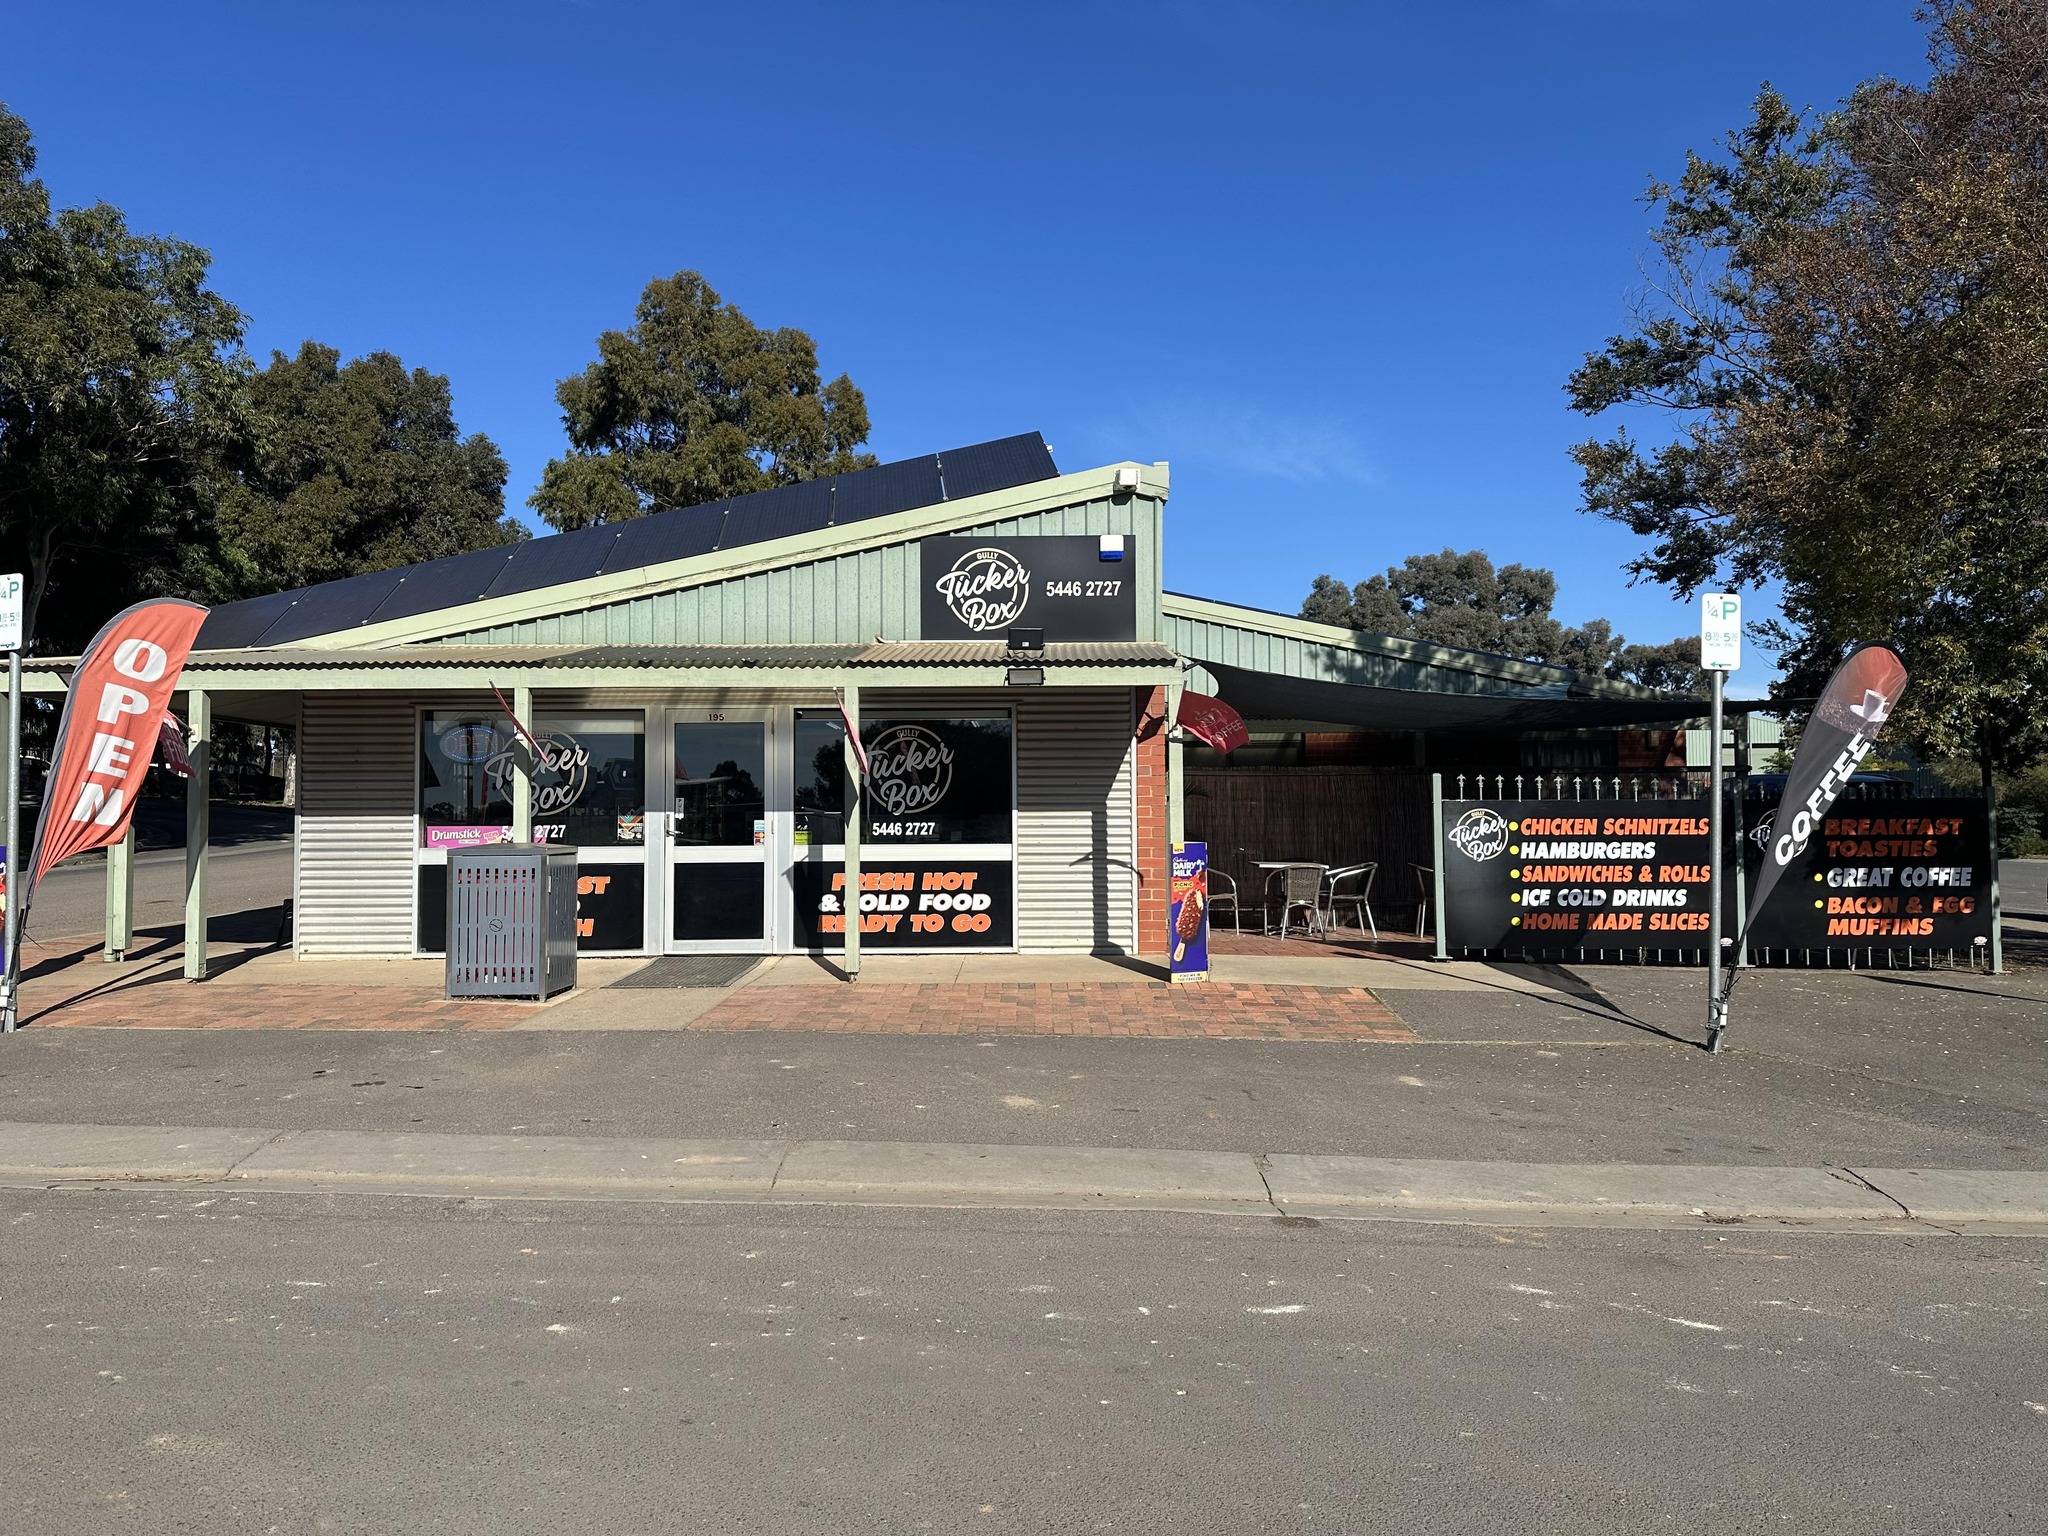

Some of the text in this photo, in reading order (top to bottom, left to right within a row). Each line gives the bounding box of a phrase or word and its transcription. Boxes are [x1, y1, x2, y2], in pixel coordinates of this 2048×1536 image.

[977, 552, 998, 560] GULLY
[936, 562, 1031, 606] Tucker
[1046, 581, 1121, 597] 5446 2727
[962, 597, 1017, 632] Box
[709, 713, 725, 721] 195
[71, 638, 167, 826] OPEN
[896, 729, 920, 737] GULLY
[1210, 720, 1244, 743] COFFEE
[444, 735, 498, 754] OPEN
[880, 779, 940, 815] Box
[1775, 732, 1871, 866] COFFEE
[432, 828, 481, 841] Drumstick
[534, 825, 566, 837] 2727
[872, 822, 935, 835] 5446 2727
[1448, 816, 1507, 848] Tucker
[1520, 818, 1710, 836] CHICKEN SCHNITZELS
[1824, 818, 1963, 836] BREAKFAST
[1468, 840, 1503, 862] Box
[1520, 842, 1656, 859] HAMBURGERS
[1827, 840, 1938, 857] TOASTIES
[1173, 862, 1197, 870] DAIRY
[1522, 865, 1711, 883] SANDWICHES & ROLLS
[921, 872, 978, 890] HOT
[1827, 867, 1973, 888] GREAT COFFEE
[818, 893, 991, 912] & OLD FOOD
[1521, 889, 1687, 907] ICE COLD DRINKS
[1827, 896, 1976, 915] BACON & EGG
[910, 914, 945, 932] TO
[951, 914, 991, 933] GO
[1522, 913, 1710, 931] HOME MADE SLICES
[1827, 918, 1934, 936] MUFFINS
